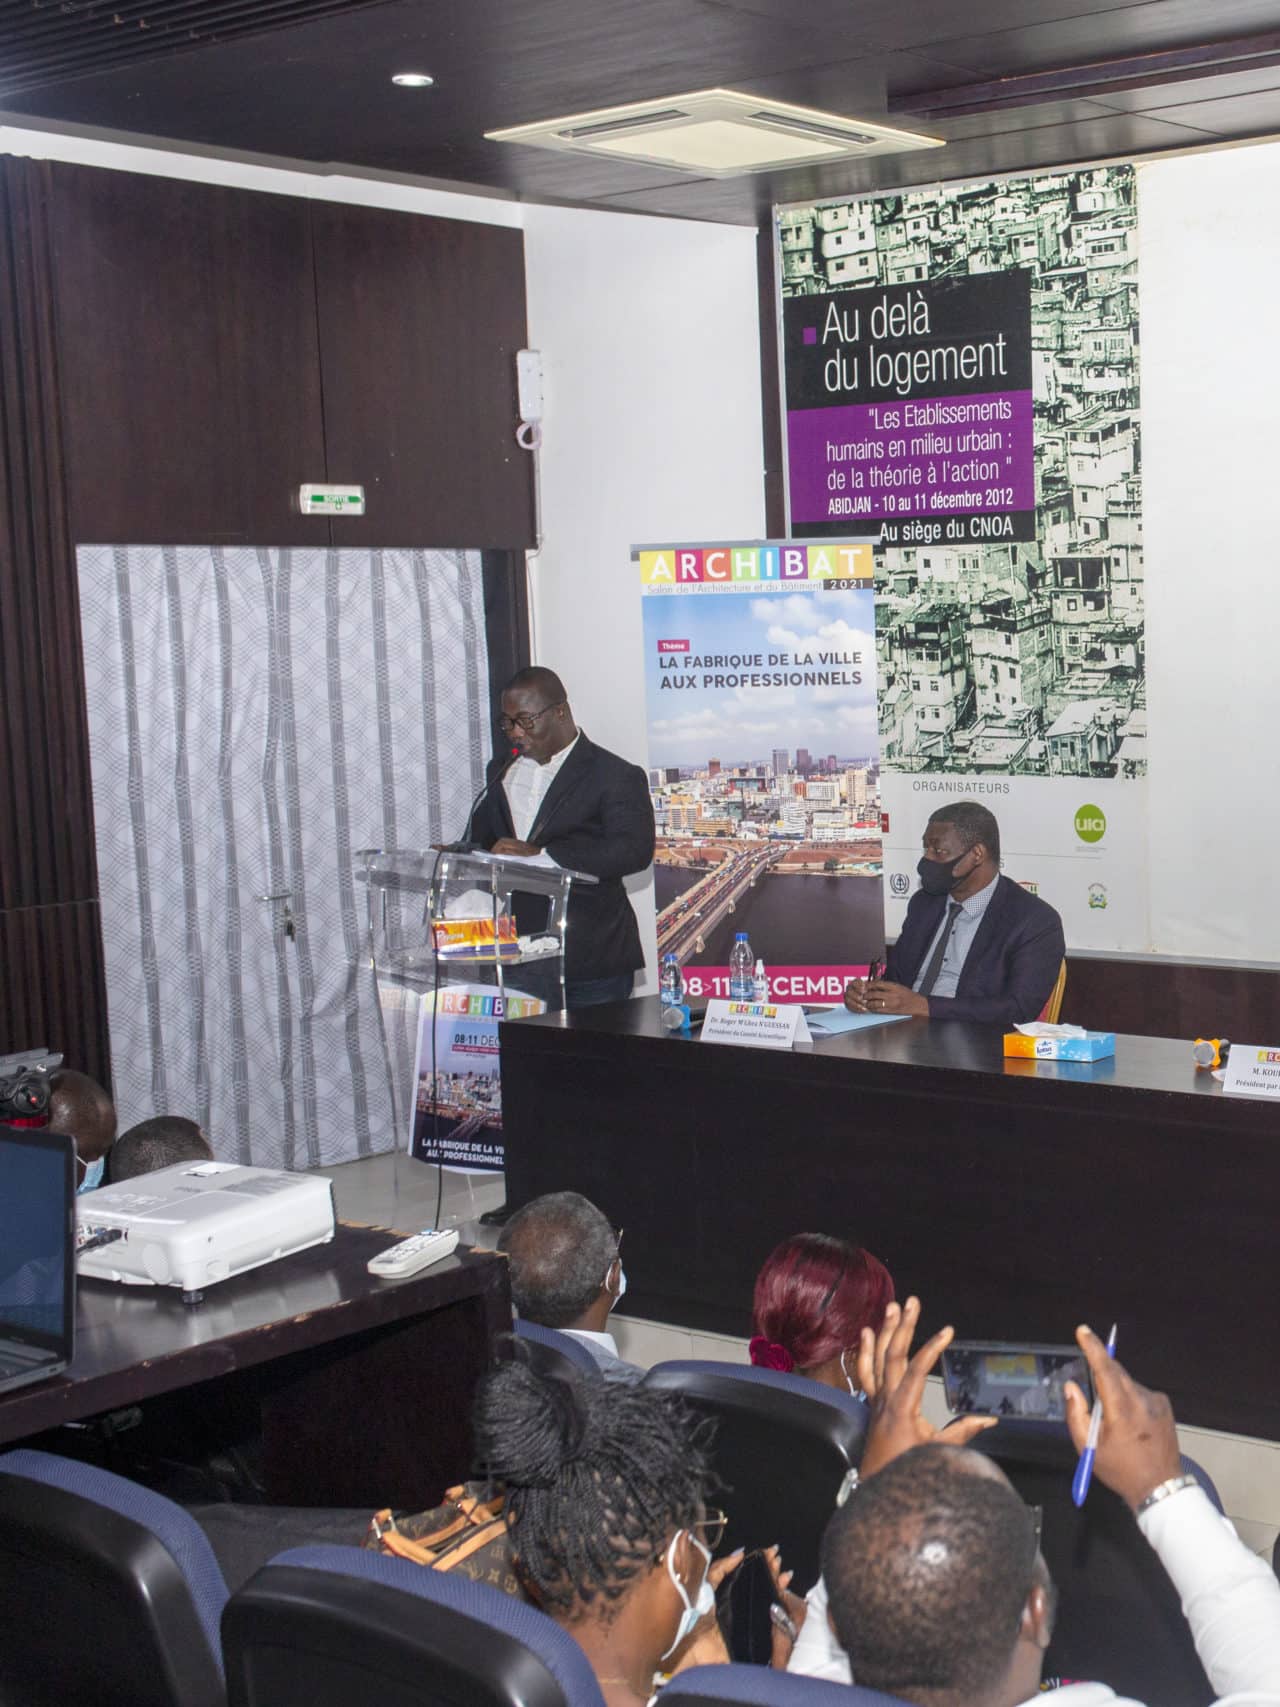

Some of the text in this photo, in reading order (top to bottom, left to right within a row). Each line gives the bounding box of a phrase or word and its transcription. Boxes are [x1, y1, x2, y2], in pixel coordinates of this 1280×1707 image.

[822, 290, 931, 345] Au delà
[824, 333, 1008, 395] du logement
[904, 398, 1012, 428] Etablissements
[826, 437, 885, 462] humains
[888, 440, 907, 458] en
[910, 433, 953, 457] milieu
[957, 430, 1003, 452] urbain
[827, 469, 846, 492] de
[850, 467, 864, 490] la
[868, 462, 922, 486] théorie
[927, 461, 937, 485] à
[942, 459, 1000, 482] l'action
[827, 495, 872, 516] ABIDJAN
[882, 493, 896, 512] 10
[897, 496, 912, 511] au
[914, 492, 928, 510] 11
[930, 488, 983, 510] décembre
[985, 487, 1014, 507] 2012
[879, 516, 1014, 543] Au siège du CNOA
[650, 548, 863, 580] ARCHIBAT
[646, 578, 865, 595] Salon de l'Architecture et du Bâtiment 2021
[658, 651, 863, 670] LA FABRIQUE DE LA VILLE
[660, 671, 863, 690] AUX PROFESSIONNELS
[912, 780, 1011, 794] ORGANISATEURS
[1075, 817, 1106, 832] uia
[1252, 1067, 1261, 1076] M.
